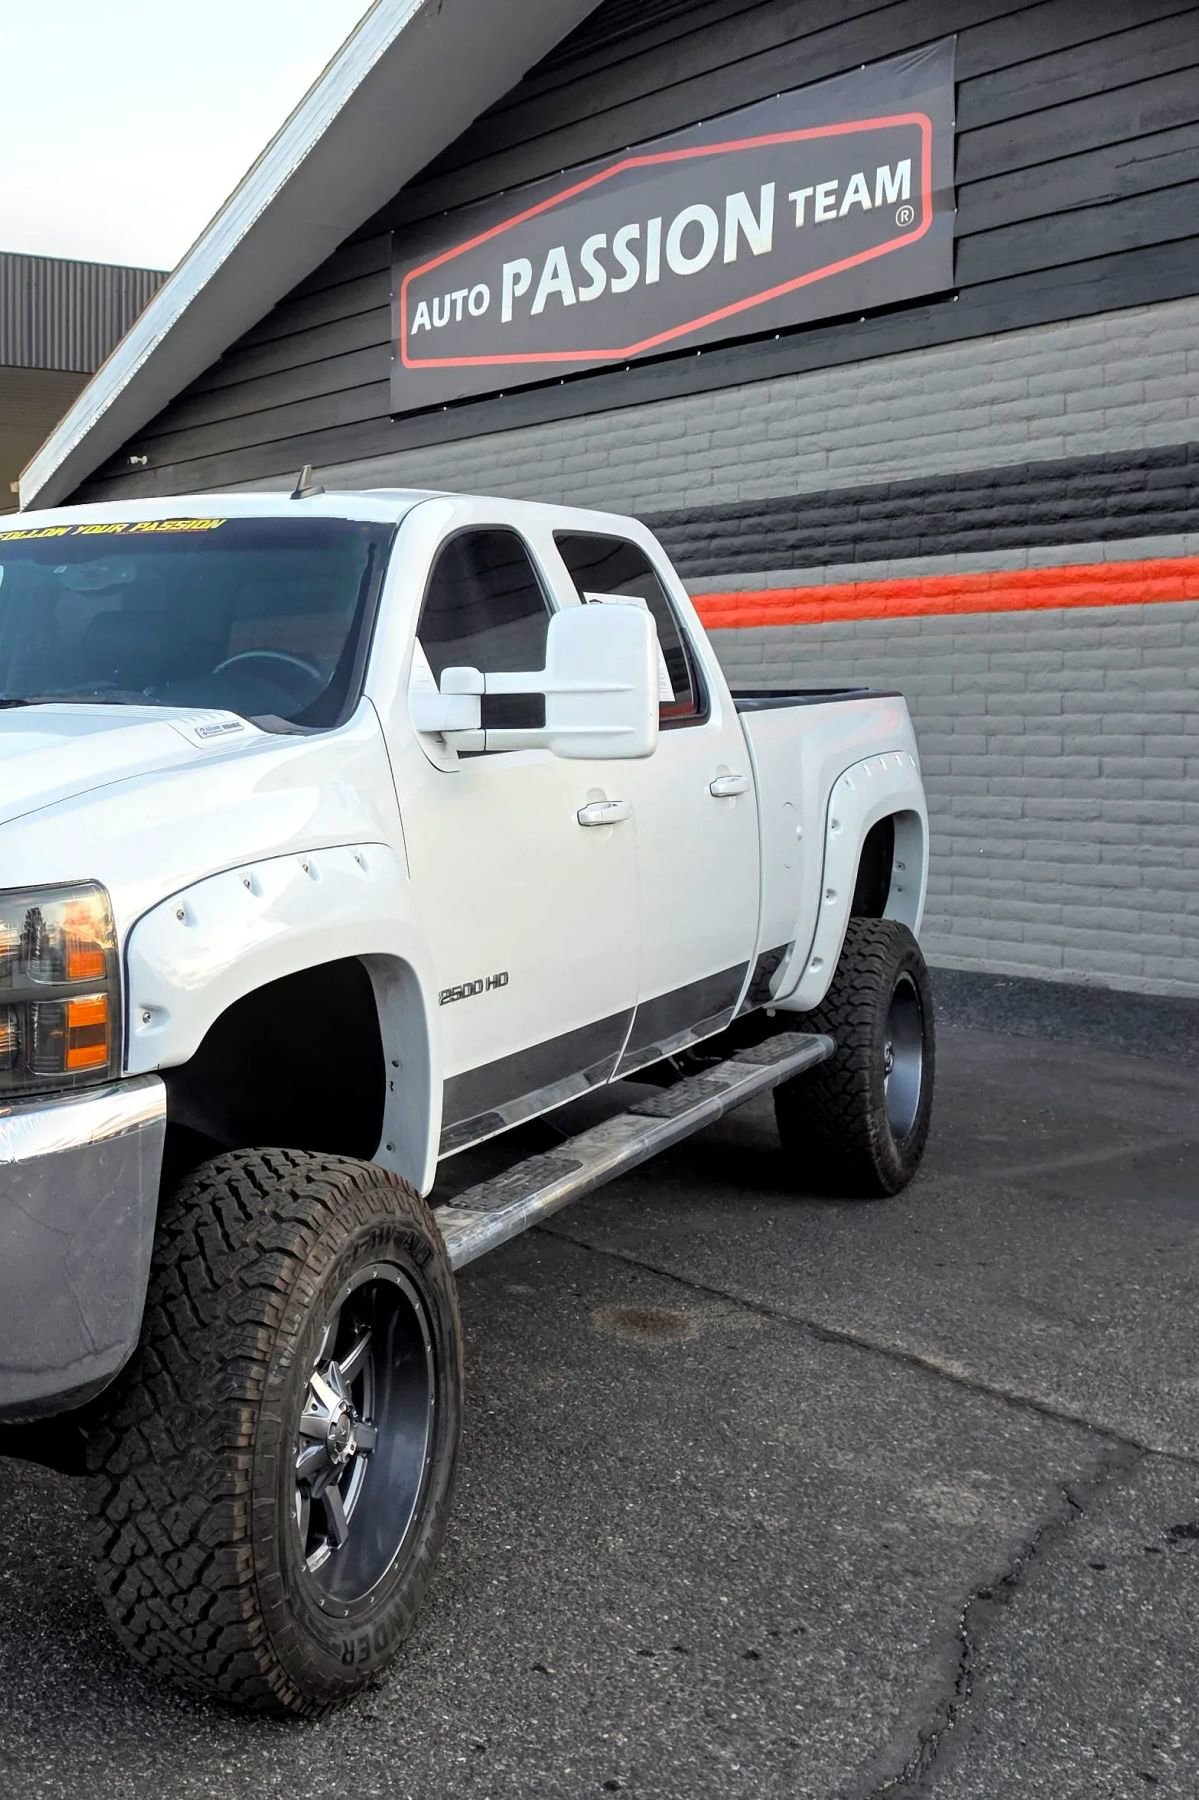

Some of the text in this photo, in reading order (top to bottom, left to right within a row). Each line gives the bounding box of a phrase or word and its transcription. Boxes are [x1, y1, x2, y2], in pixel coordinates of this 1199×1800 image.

[410, 158, 912, 335] AUTO PASSION TEAM
[70, 523, 130, 536] YOUR
[128, 519, 228, 533] PASSION
[438, 971, 509, 1007] 2500 HD
